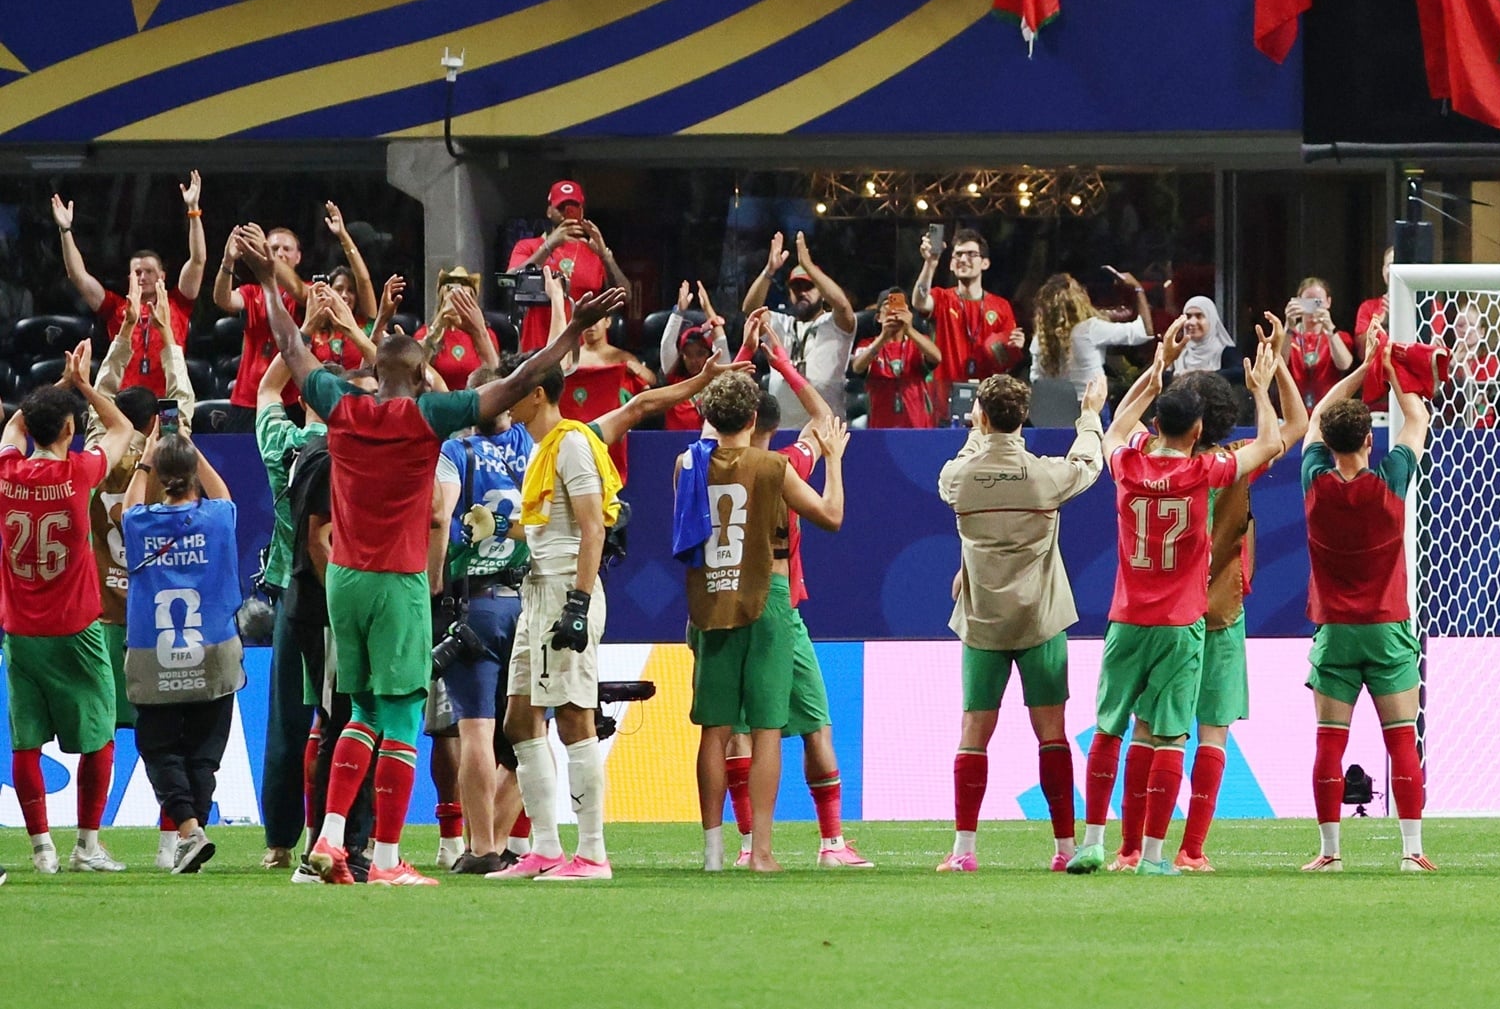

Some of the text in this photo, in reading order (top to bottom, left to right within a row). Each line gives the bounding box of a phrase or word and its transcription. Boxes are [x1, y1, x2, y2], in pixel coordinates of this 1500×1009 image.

[482, 441, 516, 457] FIFA
[475, 454, 527, 476] PHOTO
[974, 467, 1028, 488] المغرب
[0, 479, 76, 501] ALAH-EDDINE
[144, 534, 206, 550] FIFA HB
[1128, 495, 1193, 572] 17
[5, 509, 72, 583] 26
[144, 552, 209, 567] DIGITAL
[171, 652, 193, 661] FIFA
[541, 643, 549, 679] 1
[158, 669, 206, 679] WORLD CUP
[158, 678, 207, 692] 2026
